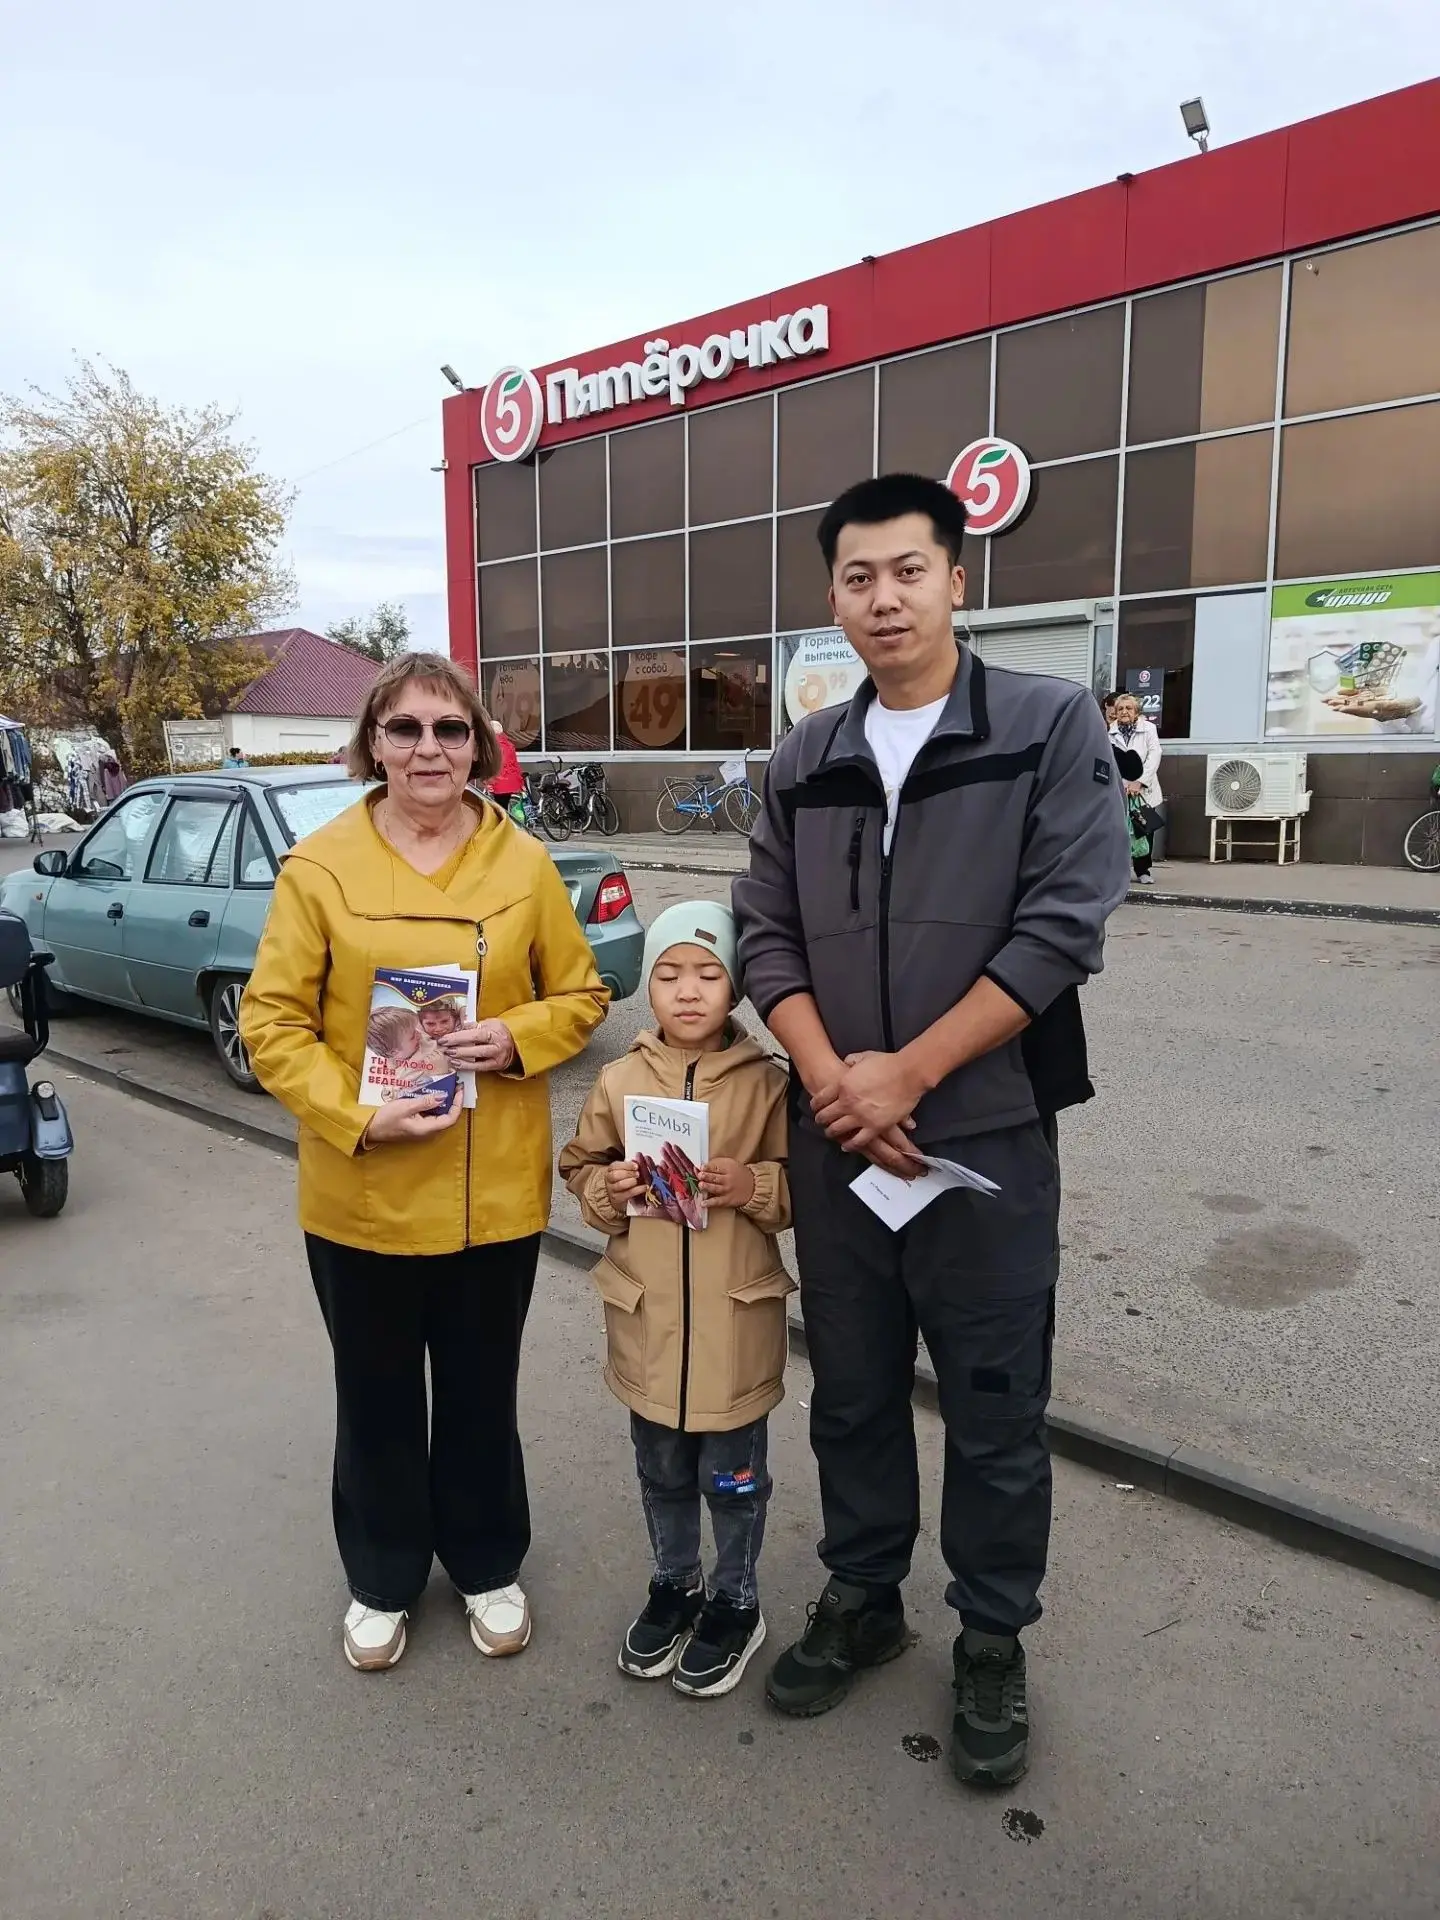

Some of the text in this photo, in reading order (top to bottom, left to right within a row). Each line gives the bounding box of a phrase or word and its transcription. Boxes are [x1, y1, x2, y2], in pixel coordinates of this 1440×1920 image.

[546, 304, 829, 424] Пятёрочка
[963, 445, 1010, 516] 5
[635, 663, 667, 674] с собой
[629, 683, 678, 730] 49
[369, 1066, 396, 1077] СЕБЯ
[371, 1056, 388, 1066] ТЫ
